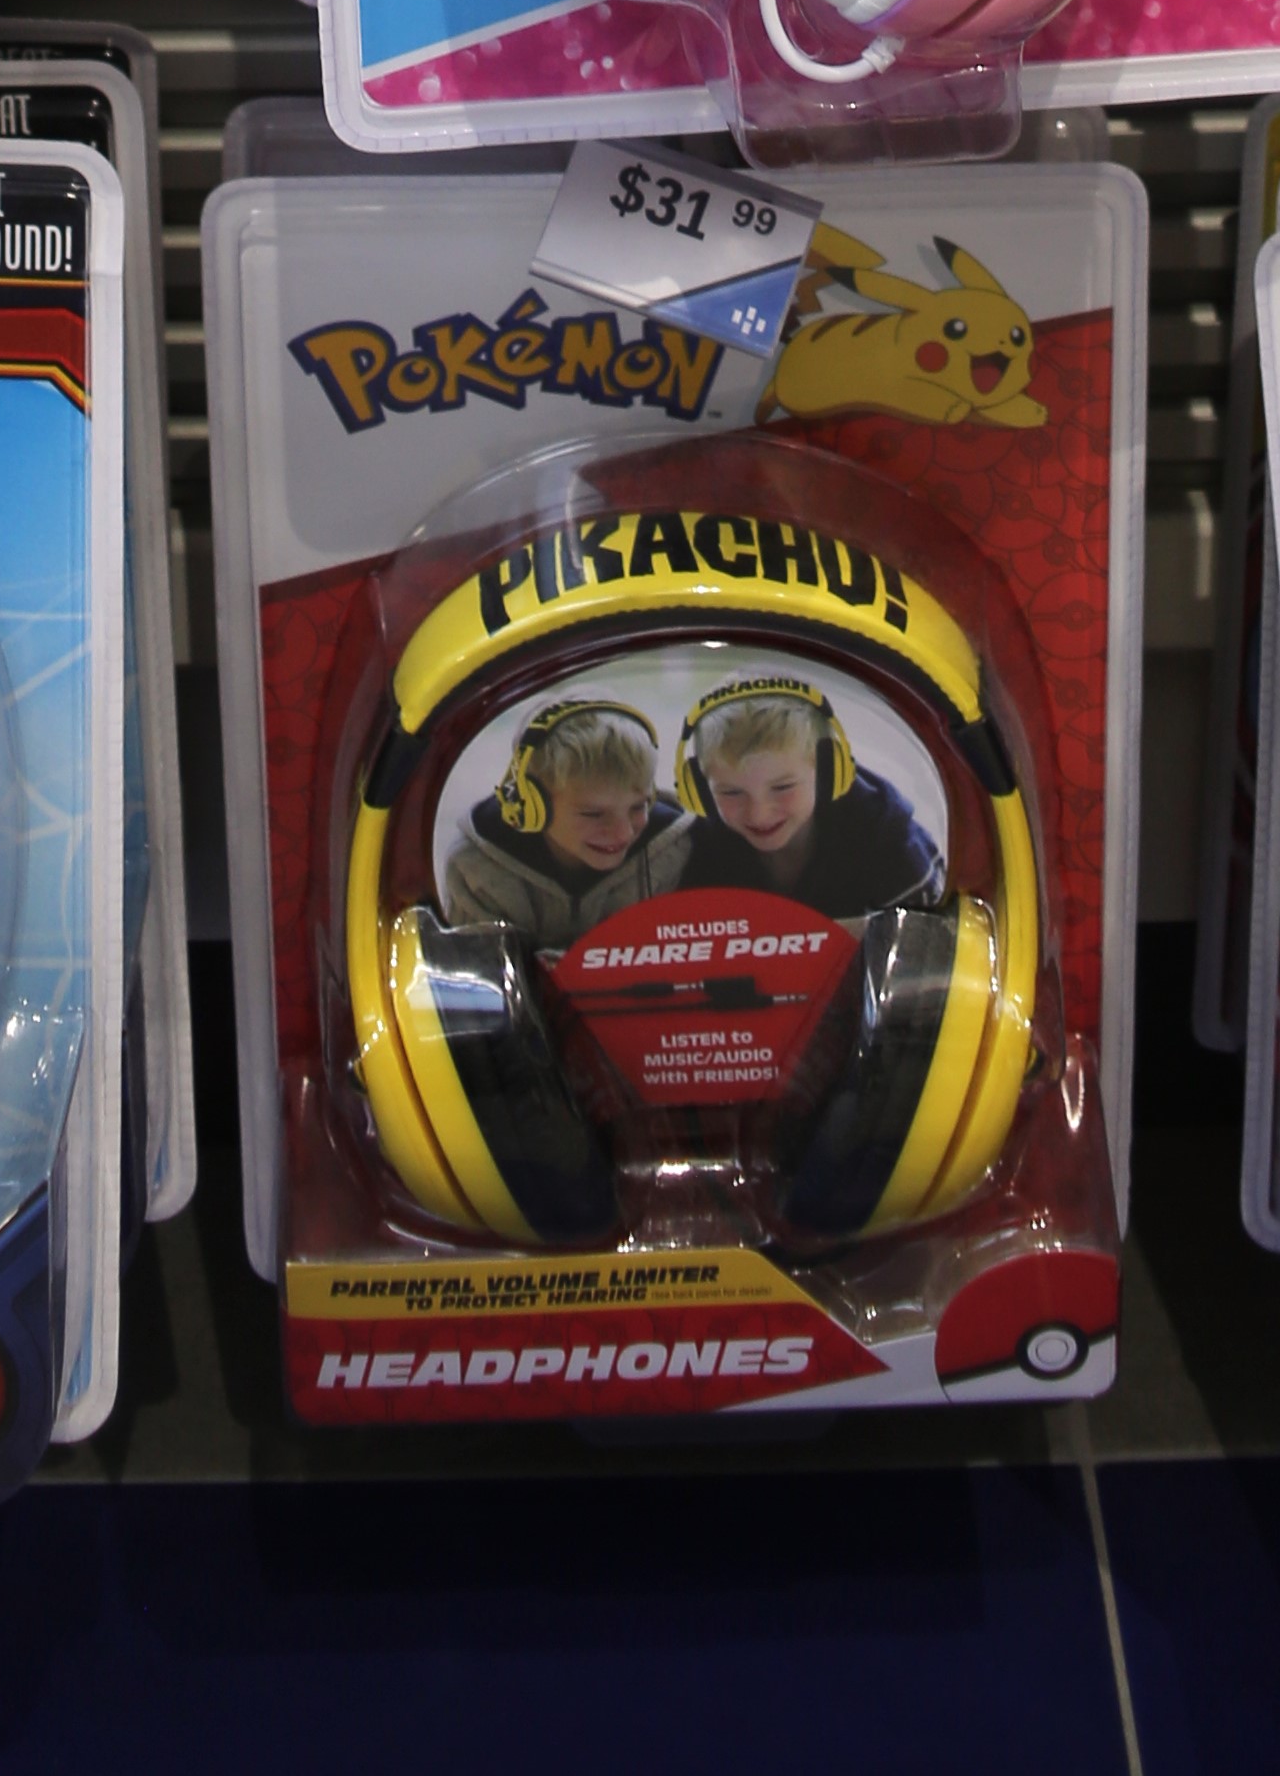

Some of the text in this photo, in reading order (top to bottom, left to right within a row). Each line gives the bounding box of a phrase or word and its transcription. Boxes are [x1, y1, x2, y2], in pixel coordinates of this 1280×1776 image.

[609, 163, 778, 242] $31 99
[479, 511, 910, 637] PIKACHU!
[582, 932, 828, 969] SHARE PORT
[657, 920, 749, 939] INCLUDES
[330, 1265, 719, 1299] PARENTAL VOLUME LIMITER
[317, 1338, 813, 1389] HEADPHONES
